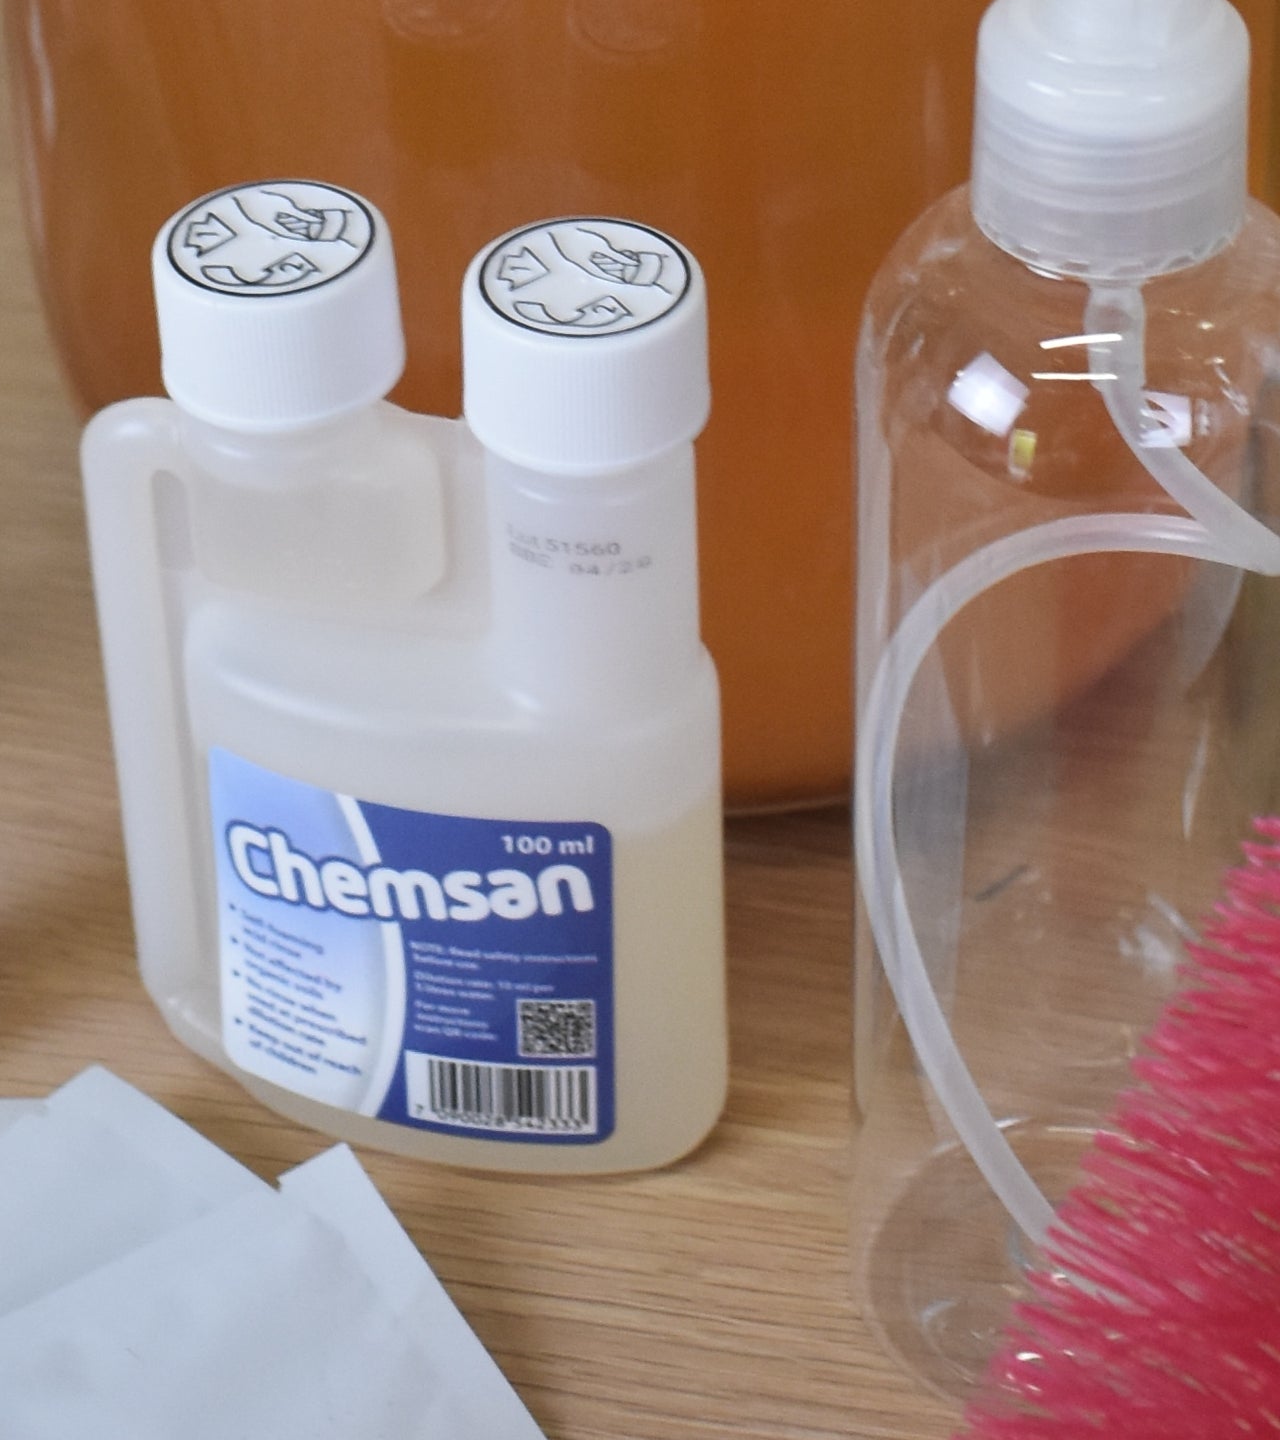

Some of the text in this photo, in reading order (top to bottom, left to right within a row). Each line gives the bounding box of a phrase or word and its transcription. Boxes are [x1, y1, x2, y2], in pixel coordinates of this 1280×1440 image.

[226, 821, 595, 921] Chemsan
[501, 834, 595, 855] 100 ml
